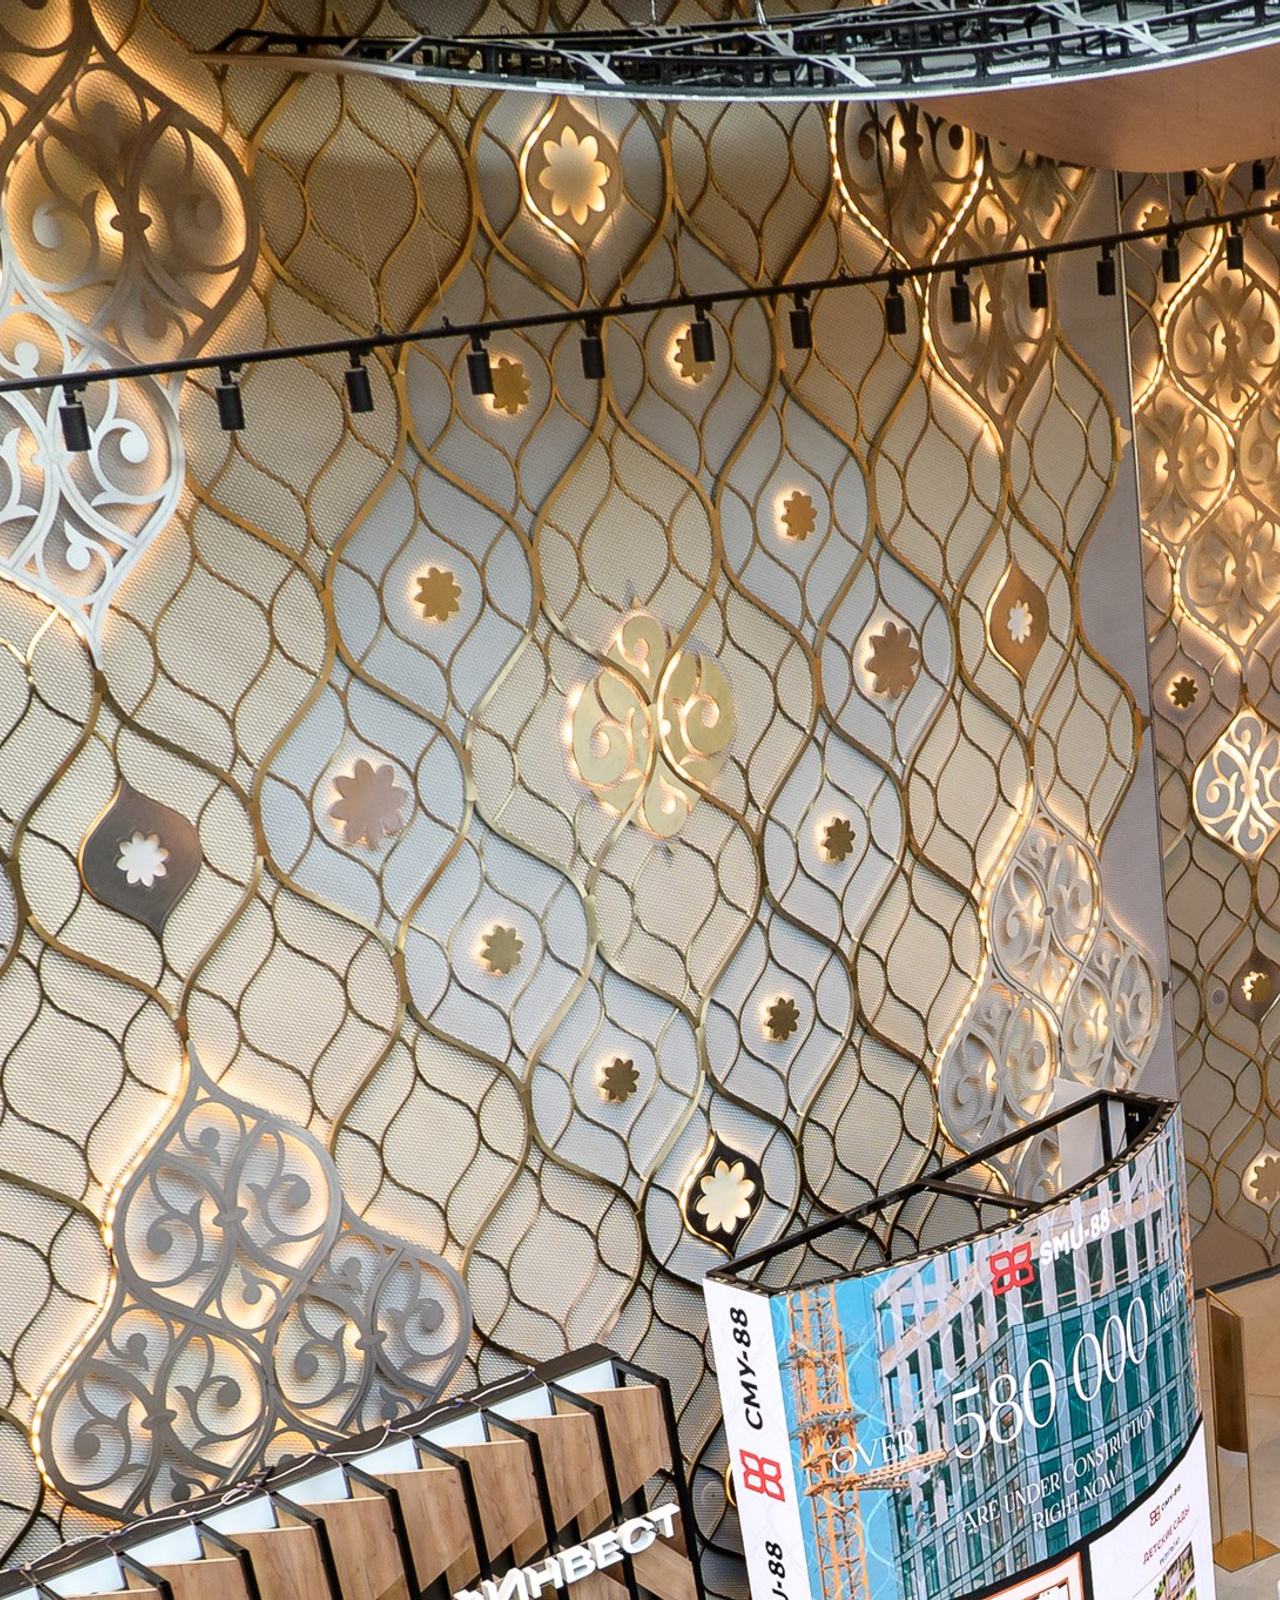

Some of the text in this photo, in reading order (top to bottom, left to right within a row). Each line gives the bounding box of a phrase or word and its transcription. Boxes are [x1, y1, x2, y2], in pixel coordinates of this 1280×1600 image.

[1039, 1208, 1110, 1266] SMU-88
[729, 1306, 764, 1431] СМУ-88
[832, 1428, 917, 1474] OVER
[951, 1358, 1057, 1460] 580
[1073, 1296, 1149, 1402] 000
[961, 1405, 1155, 1533] ARE UNDER CONSTRUCTION
[1033, 1469, 1116, 1533] RIGHT NOW
